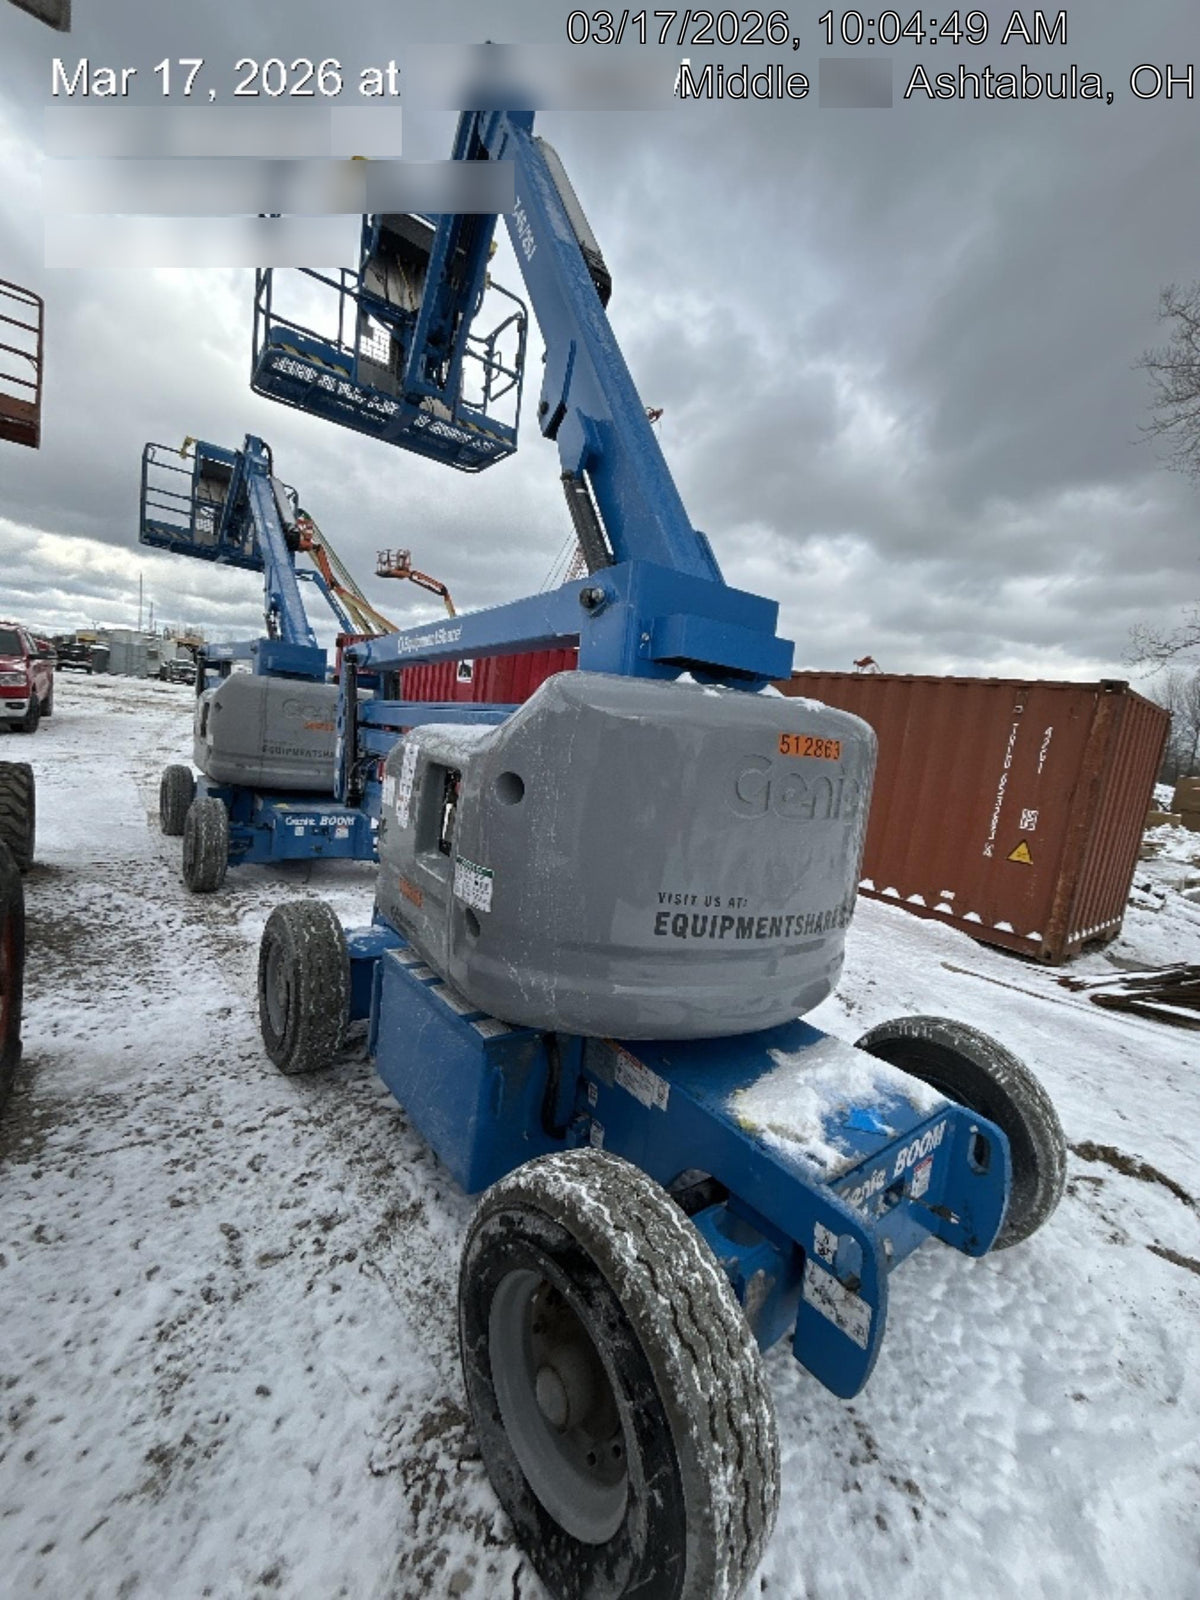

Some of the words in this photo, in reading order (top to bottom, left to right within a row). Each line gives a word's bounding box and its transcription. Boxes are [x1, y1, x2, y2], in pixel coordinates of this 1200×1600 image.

[779, 734, 841, 760] 512863
[320, 815, 356, 826] BOOM
[657, 891, 697, 906] VISIT
[703, 895, 721, 908] US
[727, 896, 748, 909] AT:
[892, 1119, 947, 1179] BOOM
